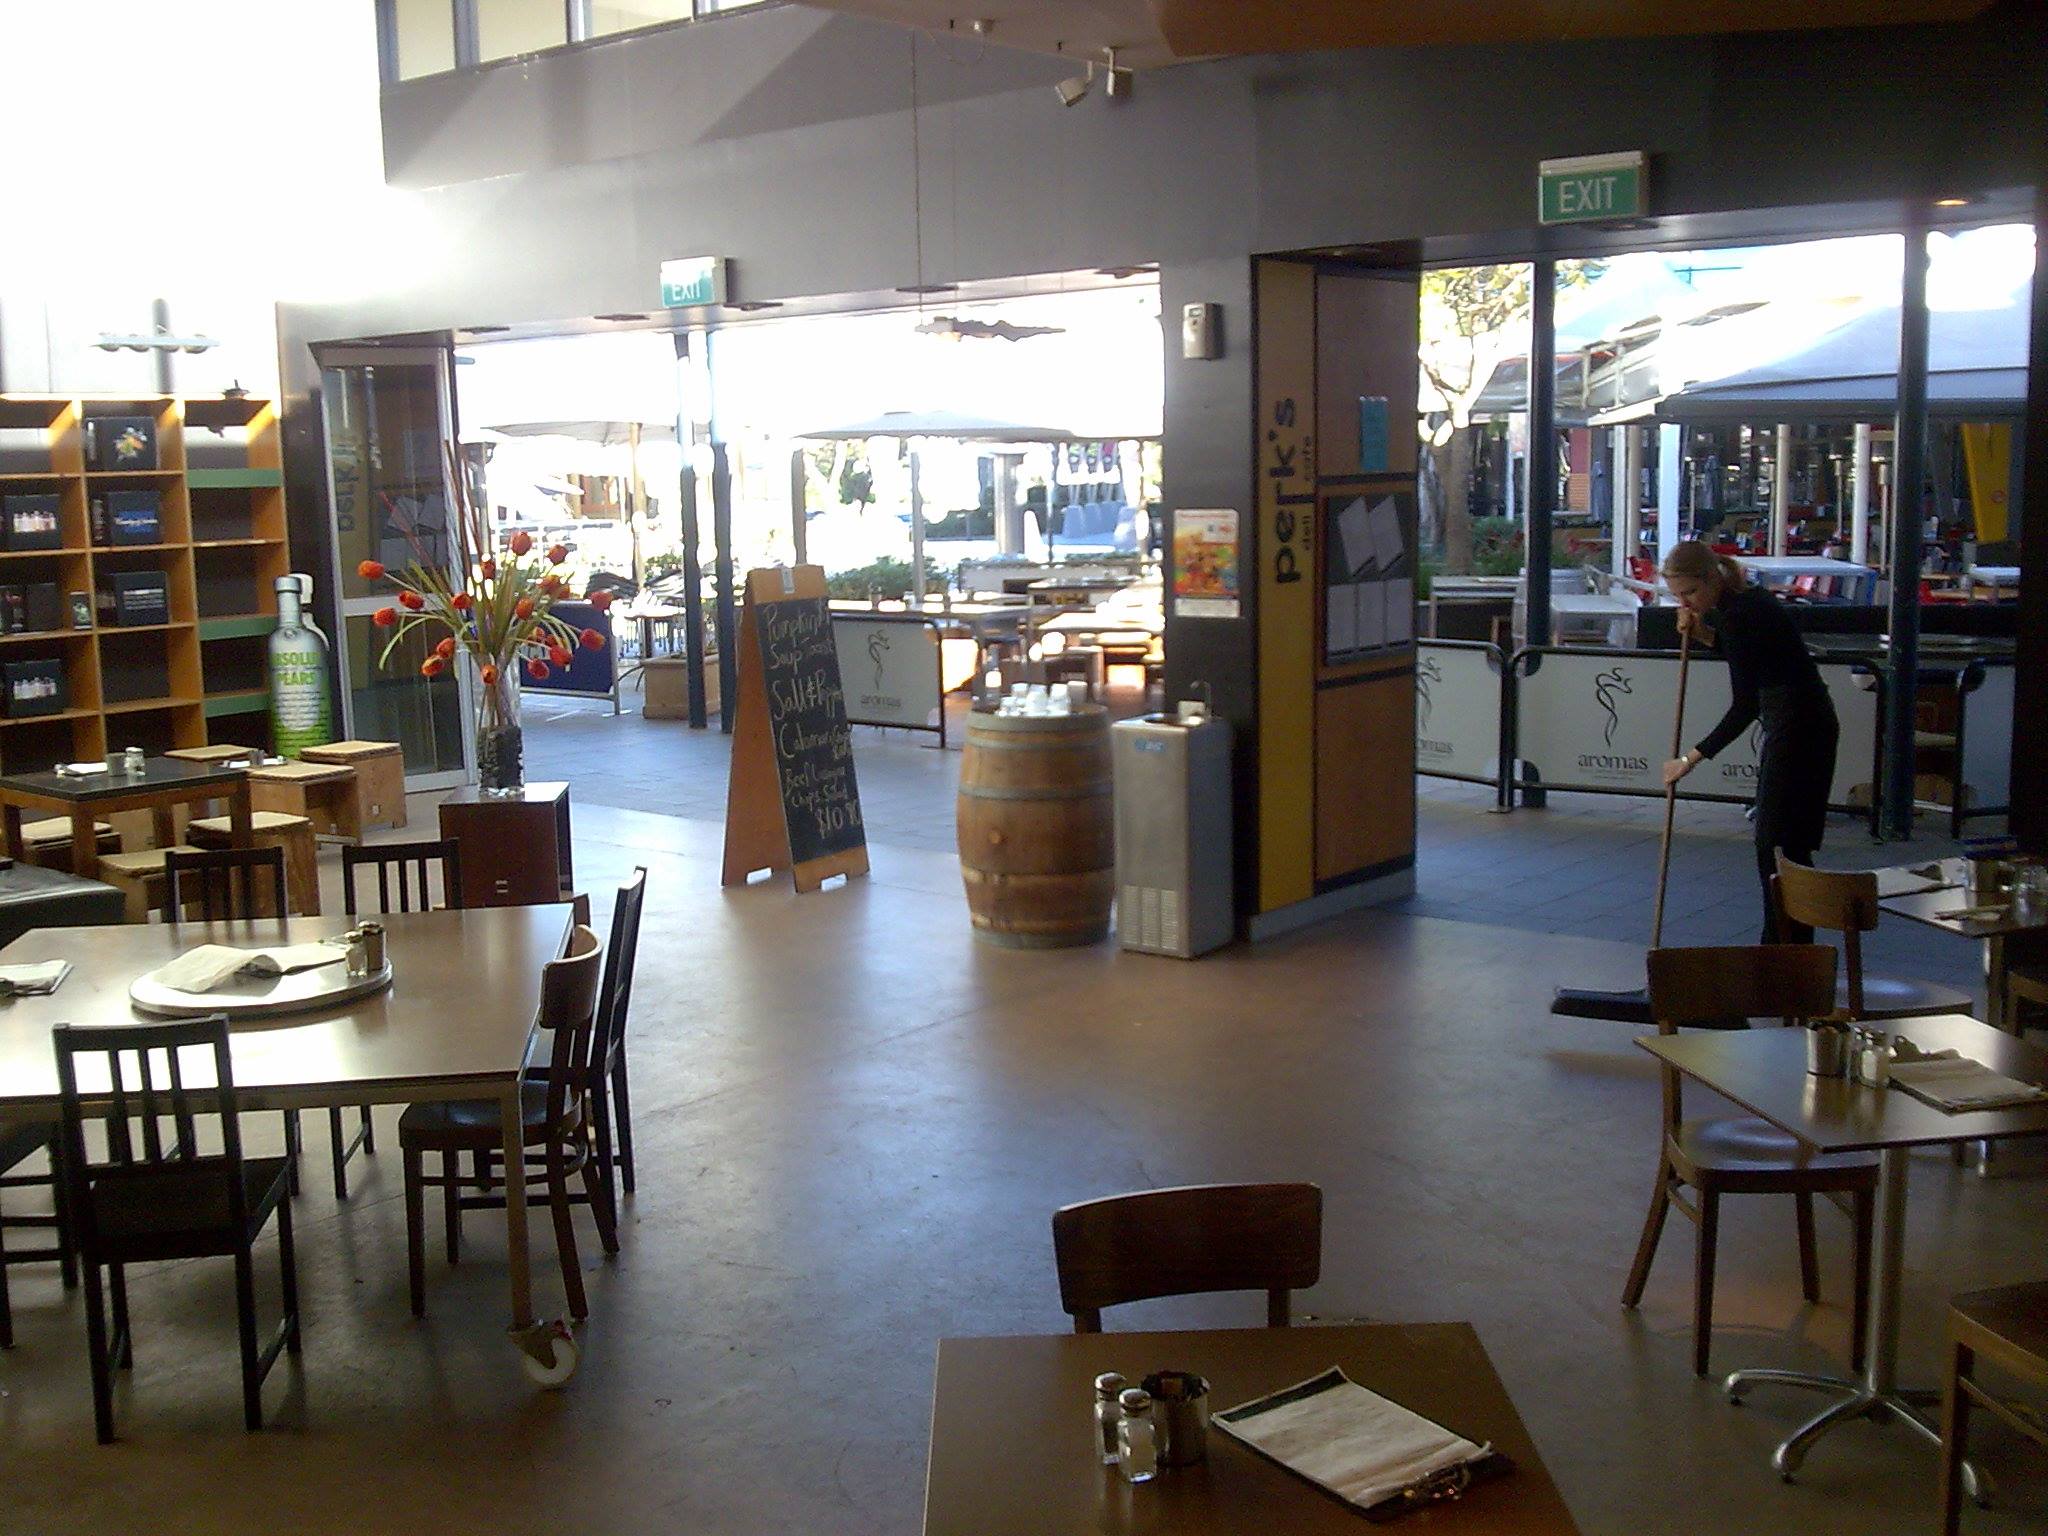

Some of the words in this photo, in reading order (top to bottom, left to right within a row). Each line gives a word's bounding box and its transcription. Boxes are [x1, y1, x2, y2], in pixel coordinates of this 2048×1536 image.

[1558, 176, 1617, 214] EXIT
[671, 279, 702, 301] EXIT
[1267, 398, 1316, 584] perk's
[1578, 753, 1649, 770] aromas
